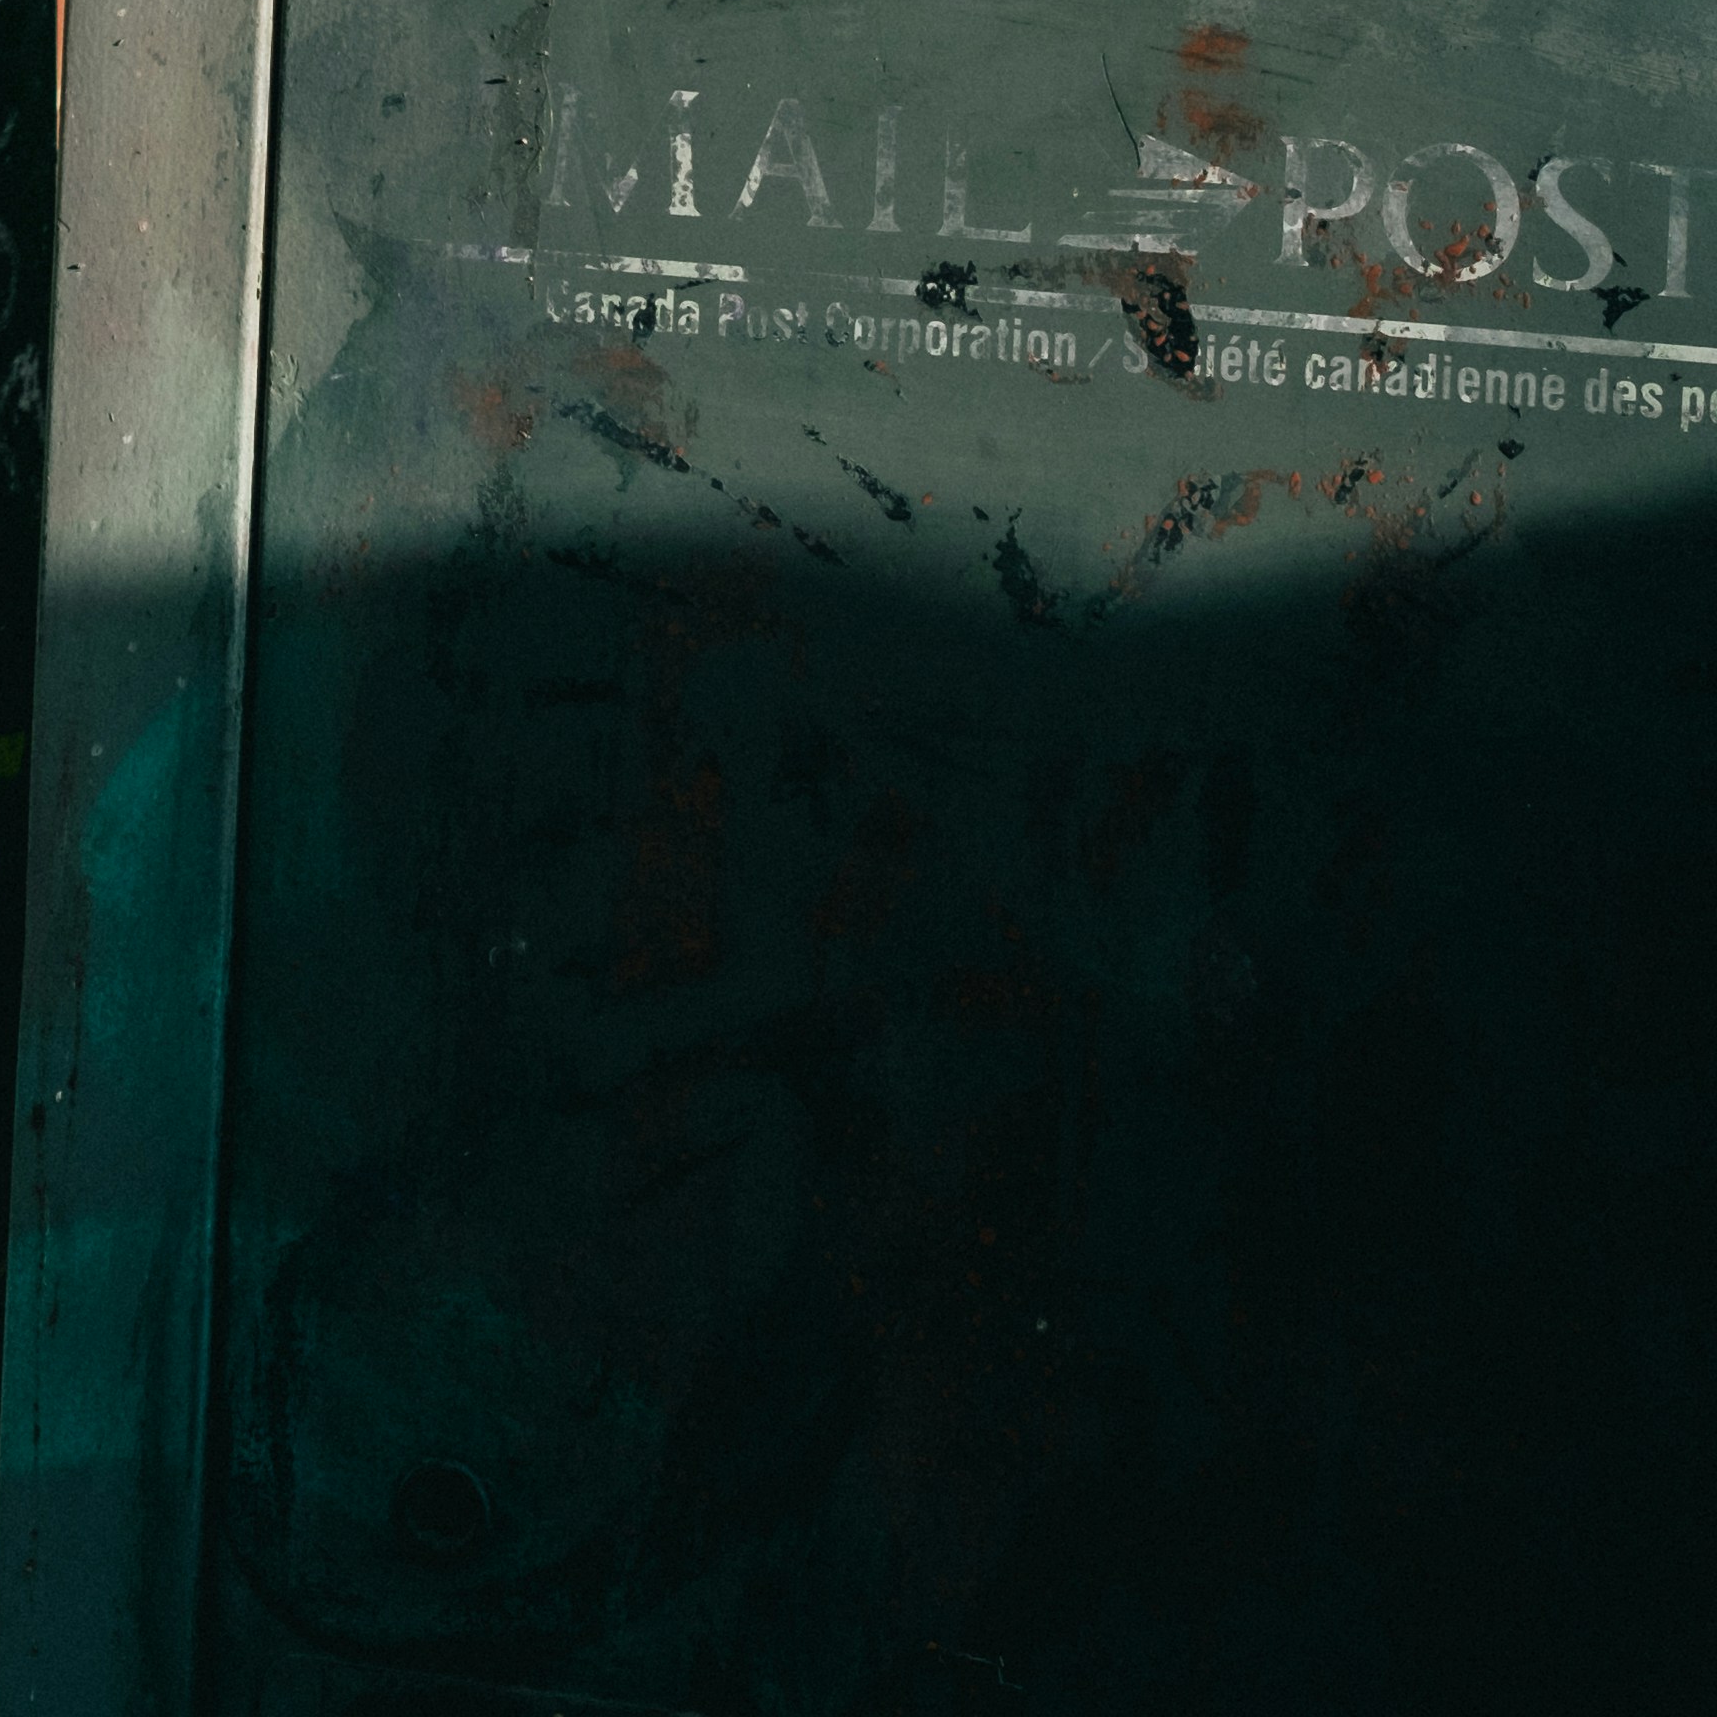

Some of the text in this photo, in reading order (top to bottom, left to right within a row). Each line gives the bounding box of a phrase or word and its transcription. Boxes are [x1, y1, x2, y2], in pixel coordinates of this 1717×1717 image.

[549, 83, 1717, 300] MAIL POST
[545, 277, 701, 338] Canada
[717, 291, 811, 345] Post
[824, 300, 1078, 368] Corporation
[1121, 328, 1288, 387] Siété
[1304, 352, 1565, 412] canadienne
[1583, 366, 1664, 417] des
